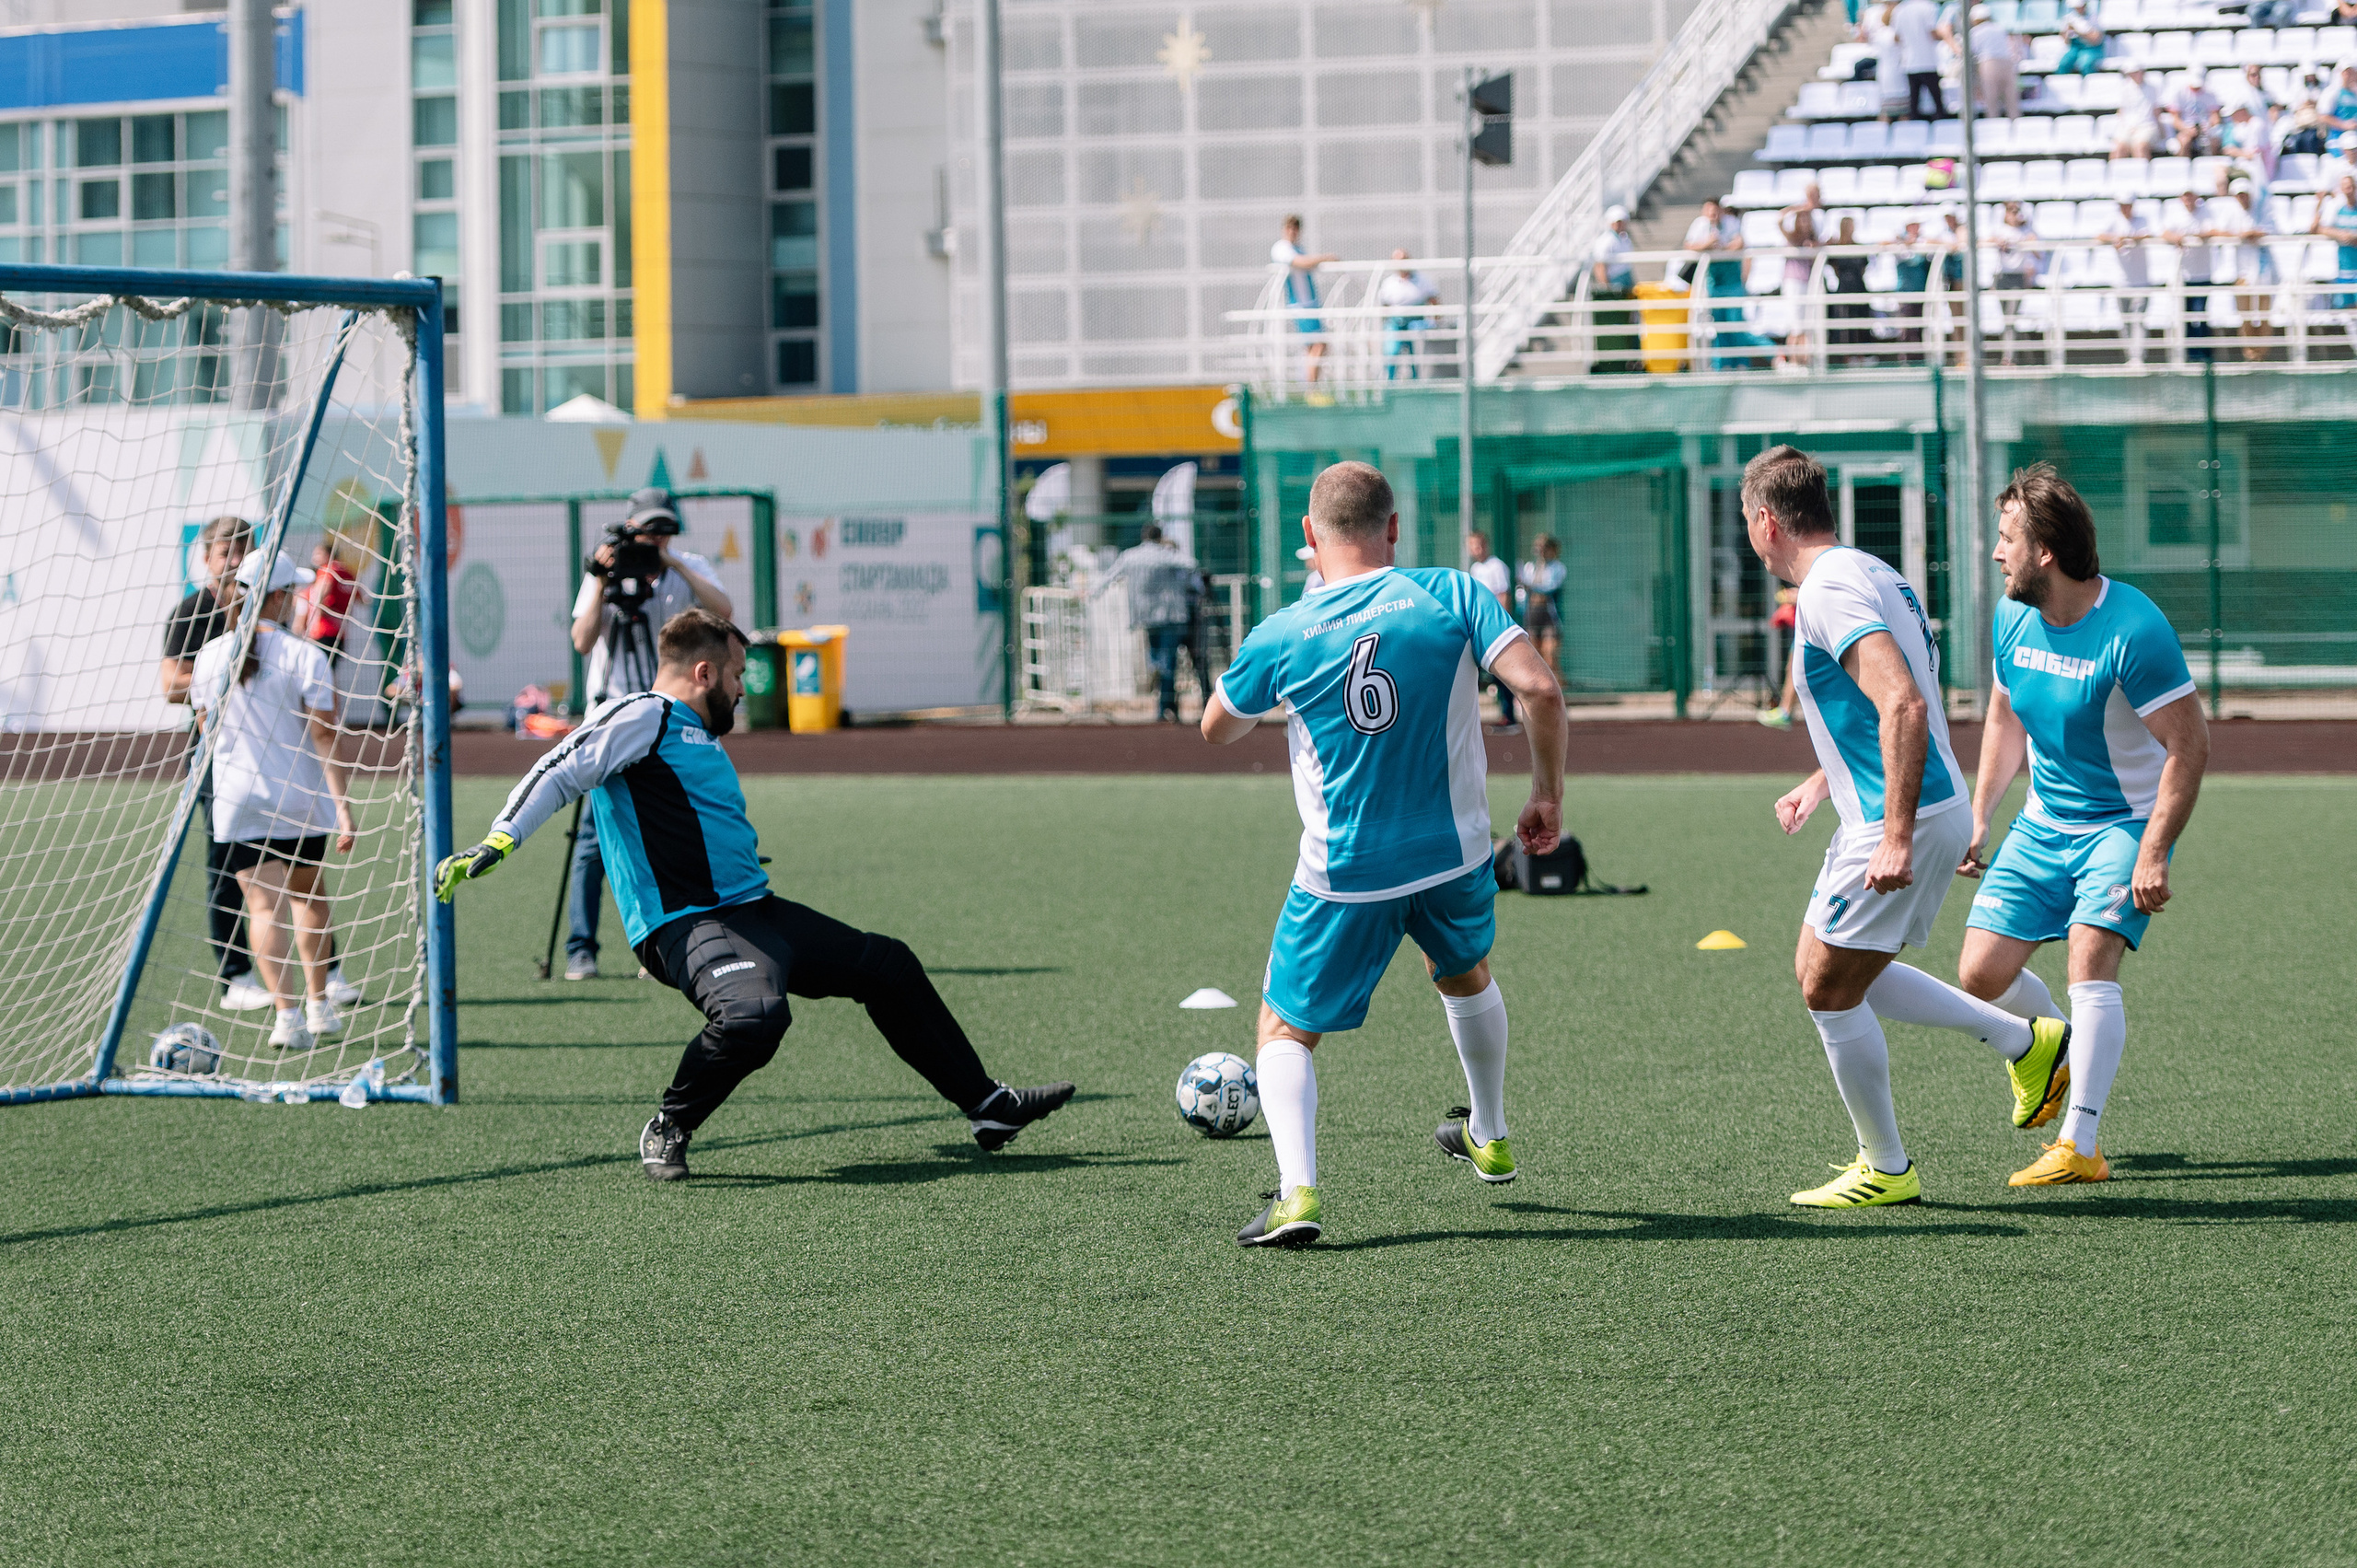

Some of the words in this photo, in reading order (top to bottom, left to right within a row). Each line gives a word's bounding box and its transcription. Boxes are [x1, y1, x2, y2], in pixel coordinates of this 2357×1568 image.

[1302, 618, 1343, 641] ХИМИЯ
[1346, 598, 1415, 626] ЛИДЕРСТВА
[2013, 645, 2096, 680] СИБУР
[1342, 633, 1399, 736] 6
[1823, 893, 1851, 935] 7
[2100, 884, 2130, 924] 2
[1222, 1087, 1240, 1131] SELECT
